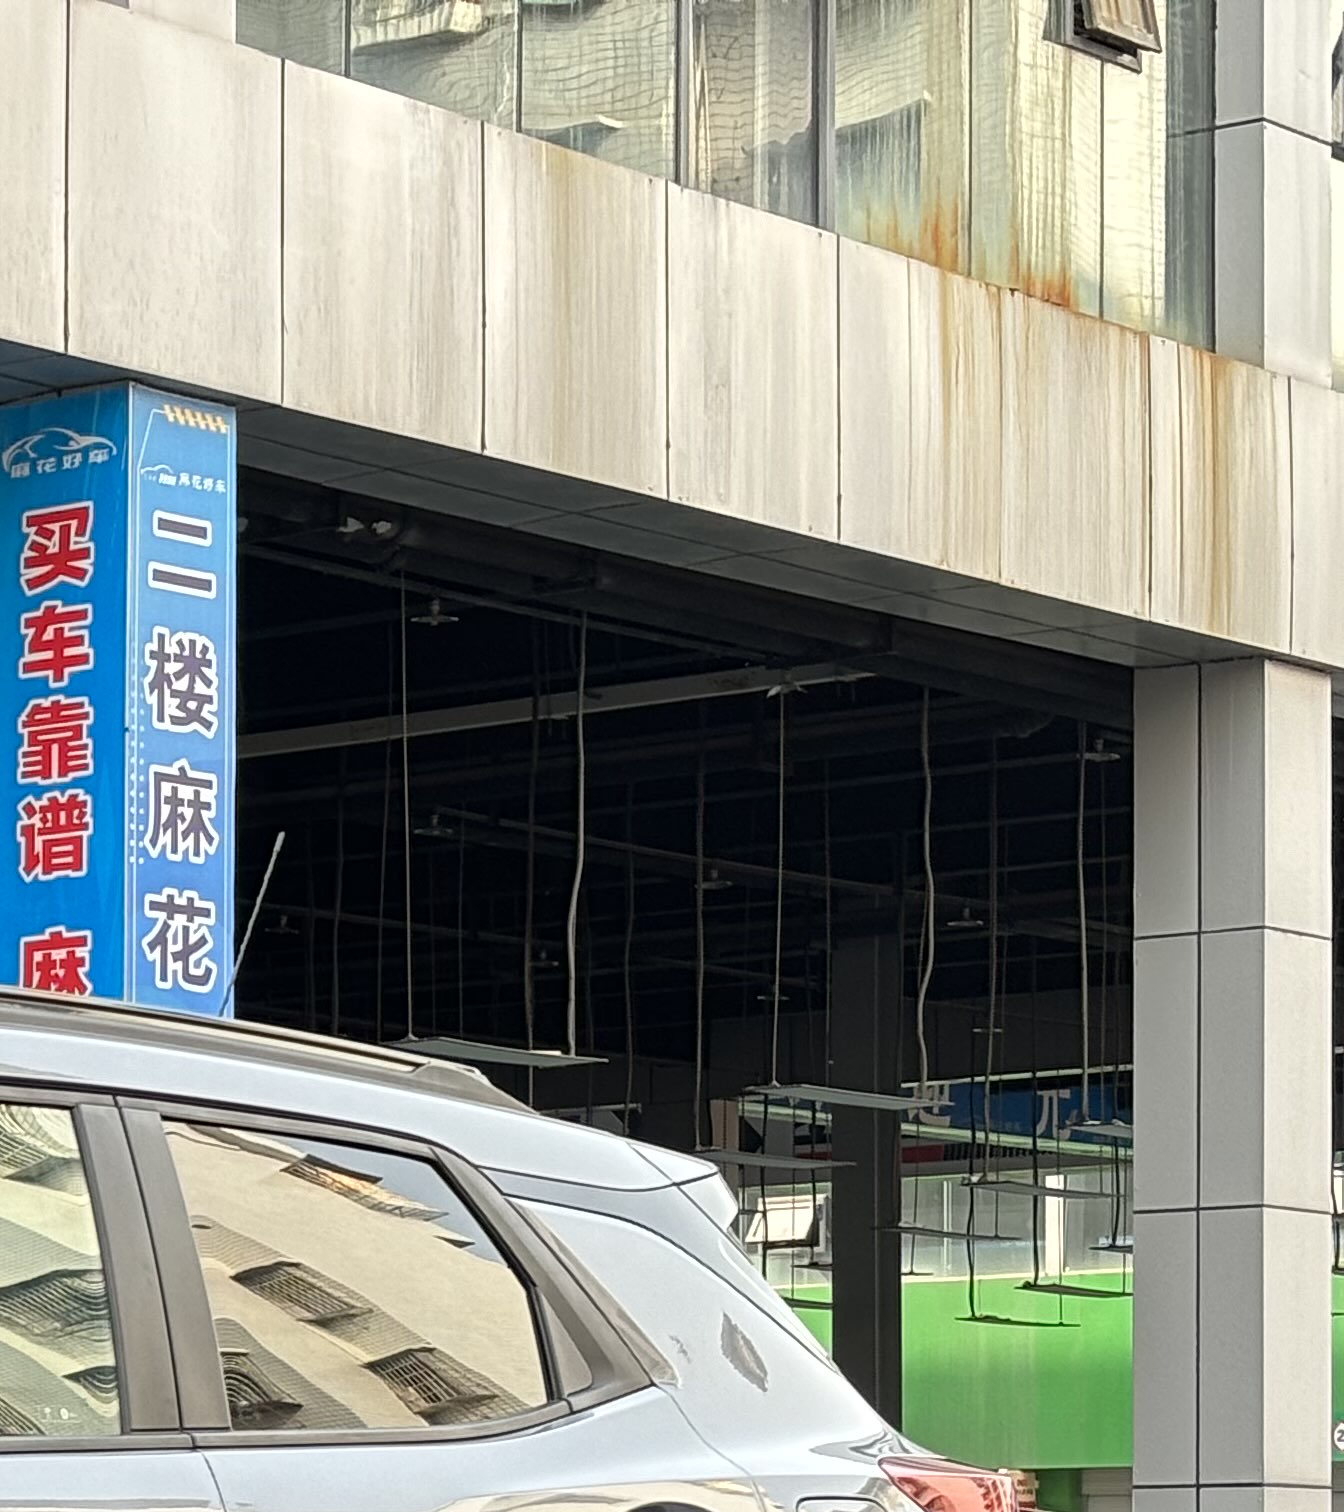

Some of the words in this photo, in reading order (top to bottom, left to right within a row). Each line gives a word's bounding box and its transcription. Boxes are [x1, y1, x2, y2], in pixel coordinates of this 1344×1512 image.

[18, 502, 95, 883] 买车靠谱
[144, 510, 219, 990] 二楼麻花
